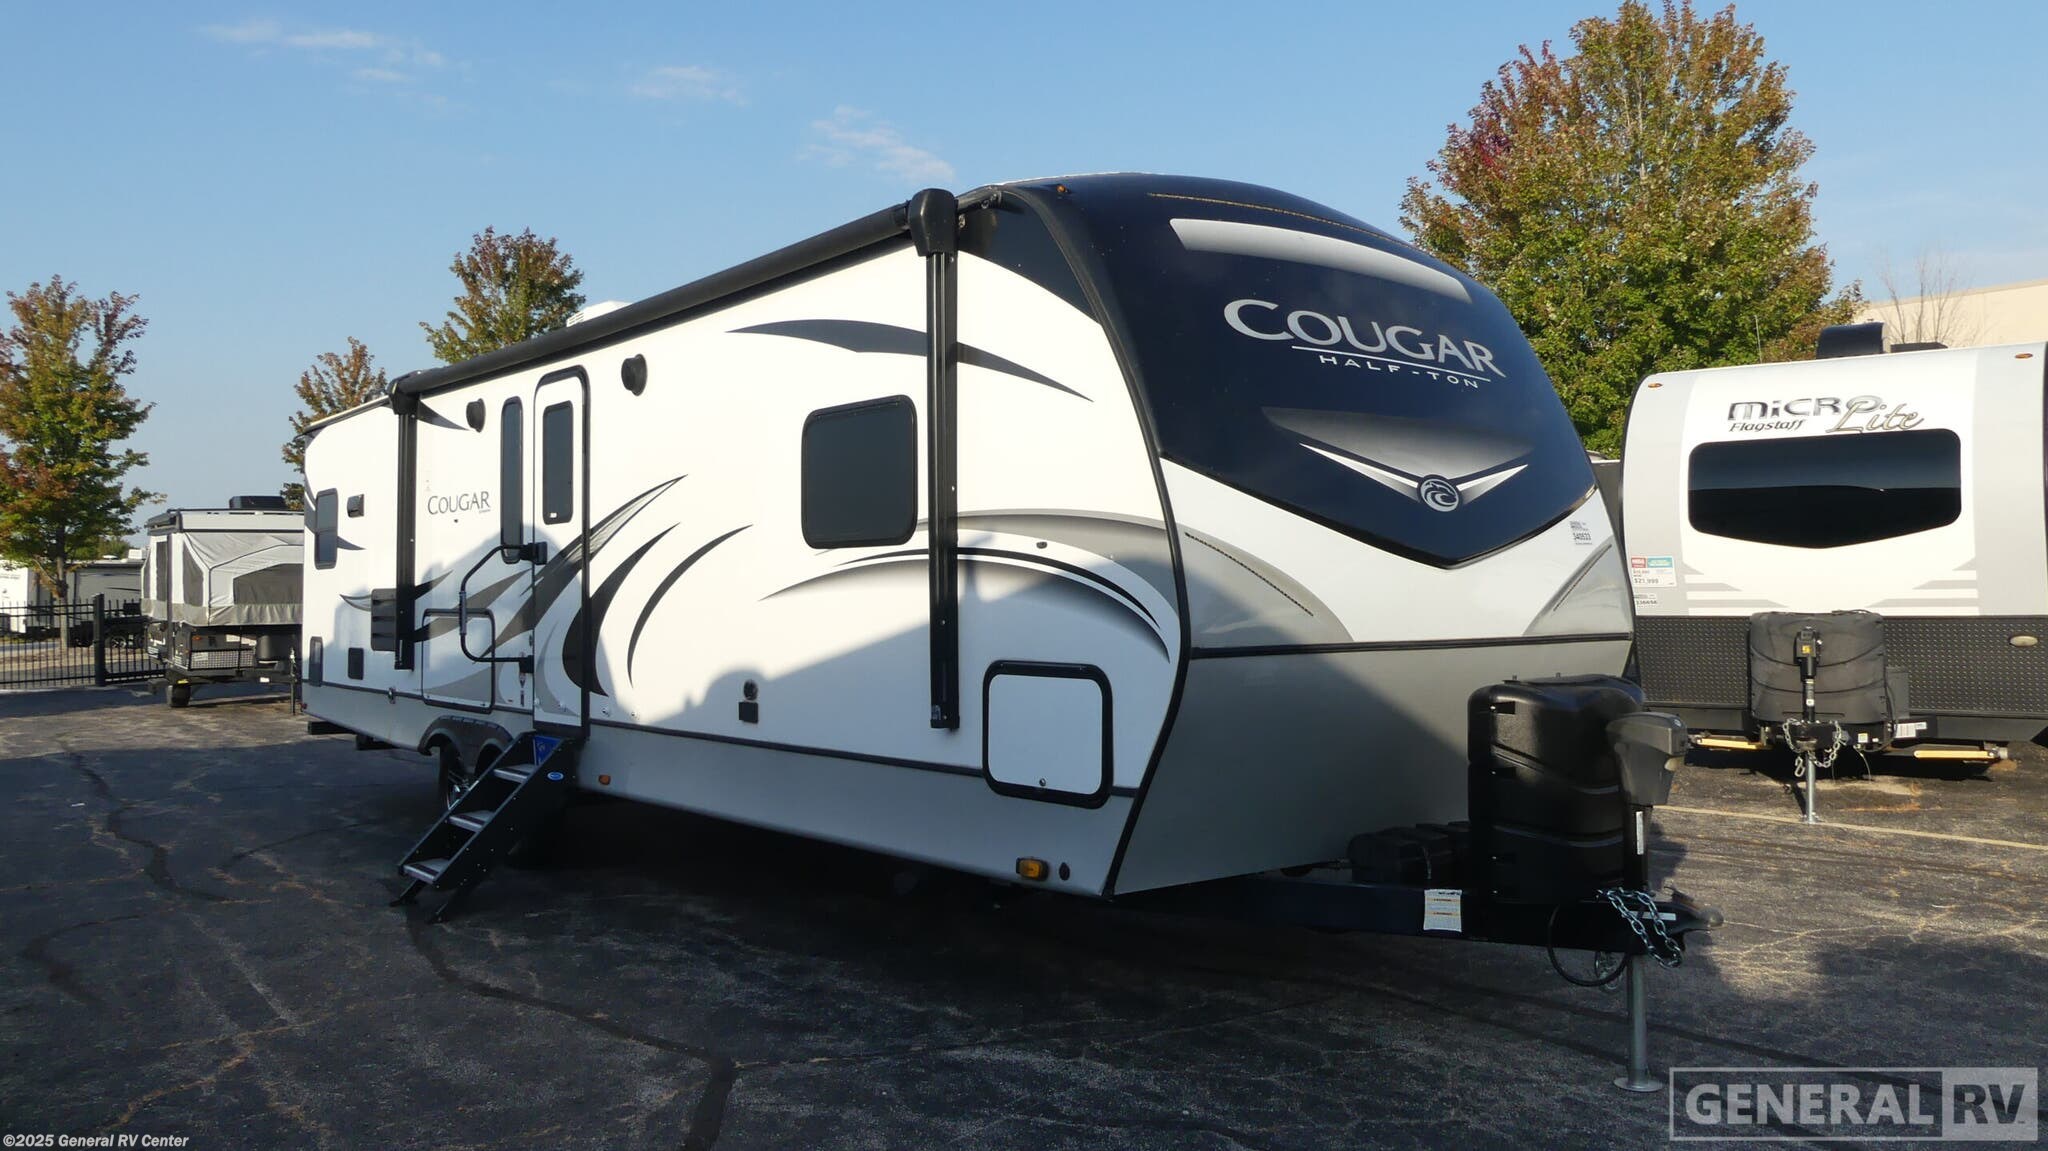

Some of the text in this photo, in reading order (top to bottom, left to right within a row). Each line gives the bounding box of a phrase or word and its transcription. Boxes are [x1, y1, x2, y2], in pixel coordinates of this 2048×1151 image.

[1223, 299, 1506, 378] COUGAR
[1319, 355, 1478, 389] HALF-TON
[1729, 418, 1805, 433] Flagstaff
[1825, 403, 1924, 434] Lite
[427, 490, 490, 515] COUGAR
